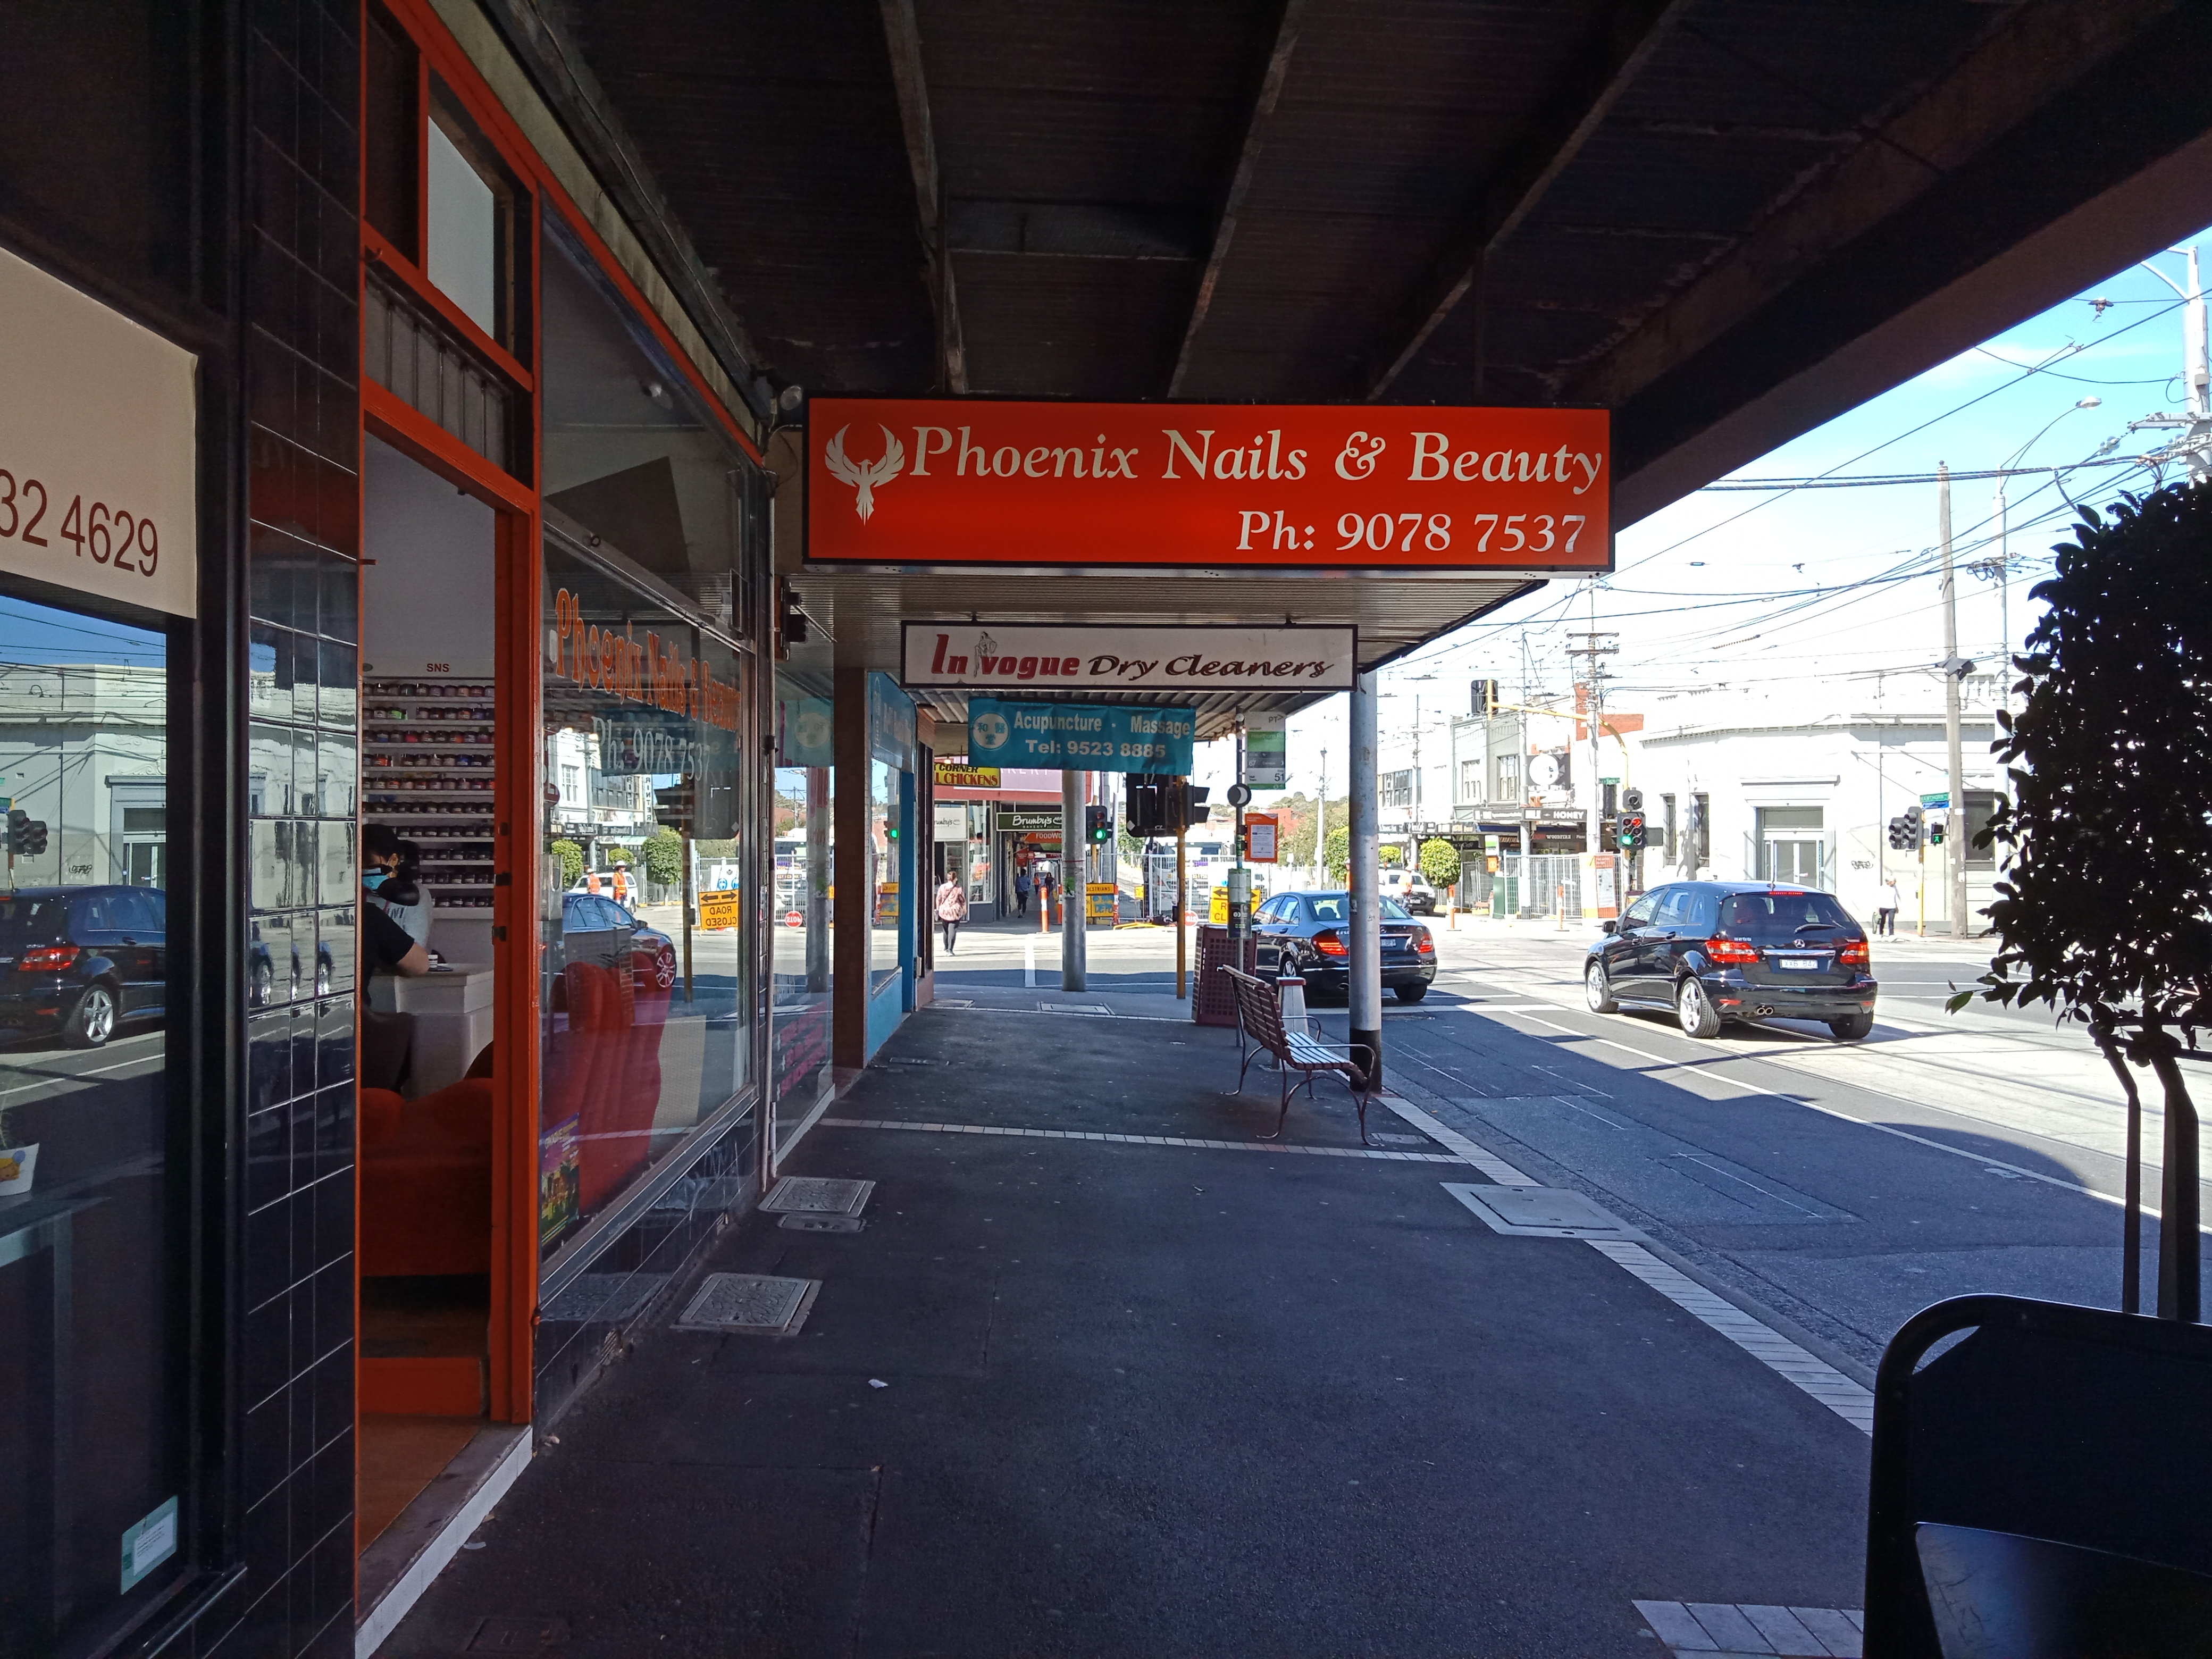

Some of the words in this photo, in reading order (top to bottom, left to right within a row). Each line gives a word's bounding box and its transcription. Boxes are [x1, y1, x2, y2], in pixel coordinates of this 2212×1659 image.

[910, 425, 1138, 479] Phoenix
[1162, 429, 1307, 480] Nails
[1335, 431, 1386, 480] &
[1407, 432, 1602, 495] Beauty
[61, 495, 158, 577] 4629
[1236, 510, 1315, 551] Ph:
[1336, 513, 1452, 552] 9078
[1475, 513, 1586, 553] 7537
[556, 588, 642, 705] Phoenix
[647, 630, 686, 717] Nails
[931, 633, 968, 674] In
[981, 656, 1080, 680] vogue
[1088, 655, 1159, 681] Dry
[1165, 653, 1335, 678] Cleaners
[426, 664, 449, 672] SNS
[1013, 711, 1102, 734] Acupuncture
[1130, 715, 1191, 739] Massage
[633, 727, 673, 775] 9078
[680, 738, 710, 782] 7537
[1025, 740, 1061, 754] Tel:
[1067, 741, 1113, 756] 9523
[1120, 742, 1166, 758] 8885
[939, 764, 978, 773] CORNER
[944, 773, 998, 786] CHICKENS
[934, 818, 952, 827] rumby's
[1012, 815, 1052, 827] Brumby's
[1553, 810, 1584, 819] HONEY
